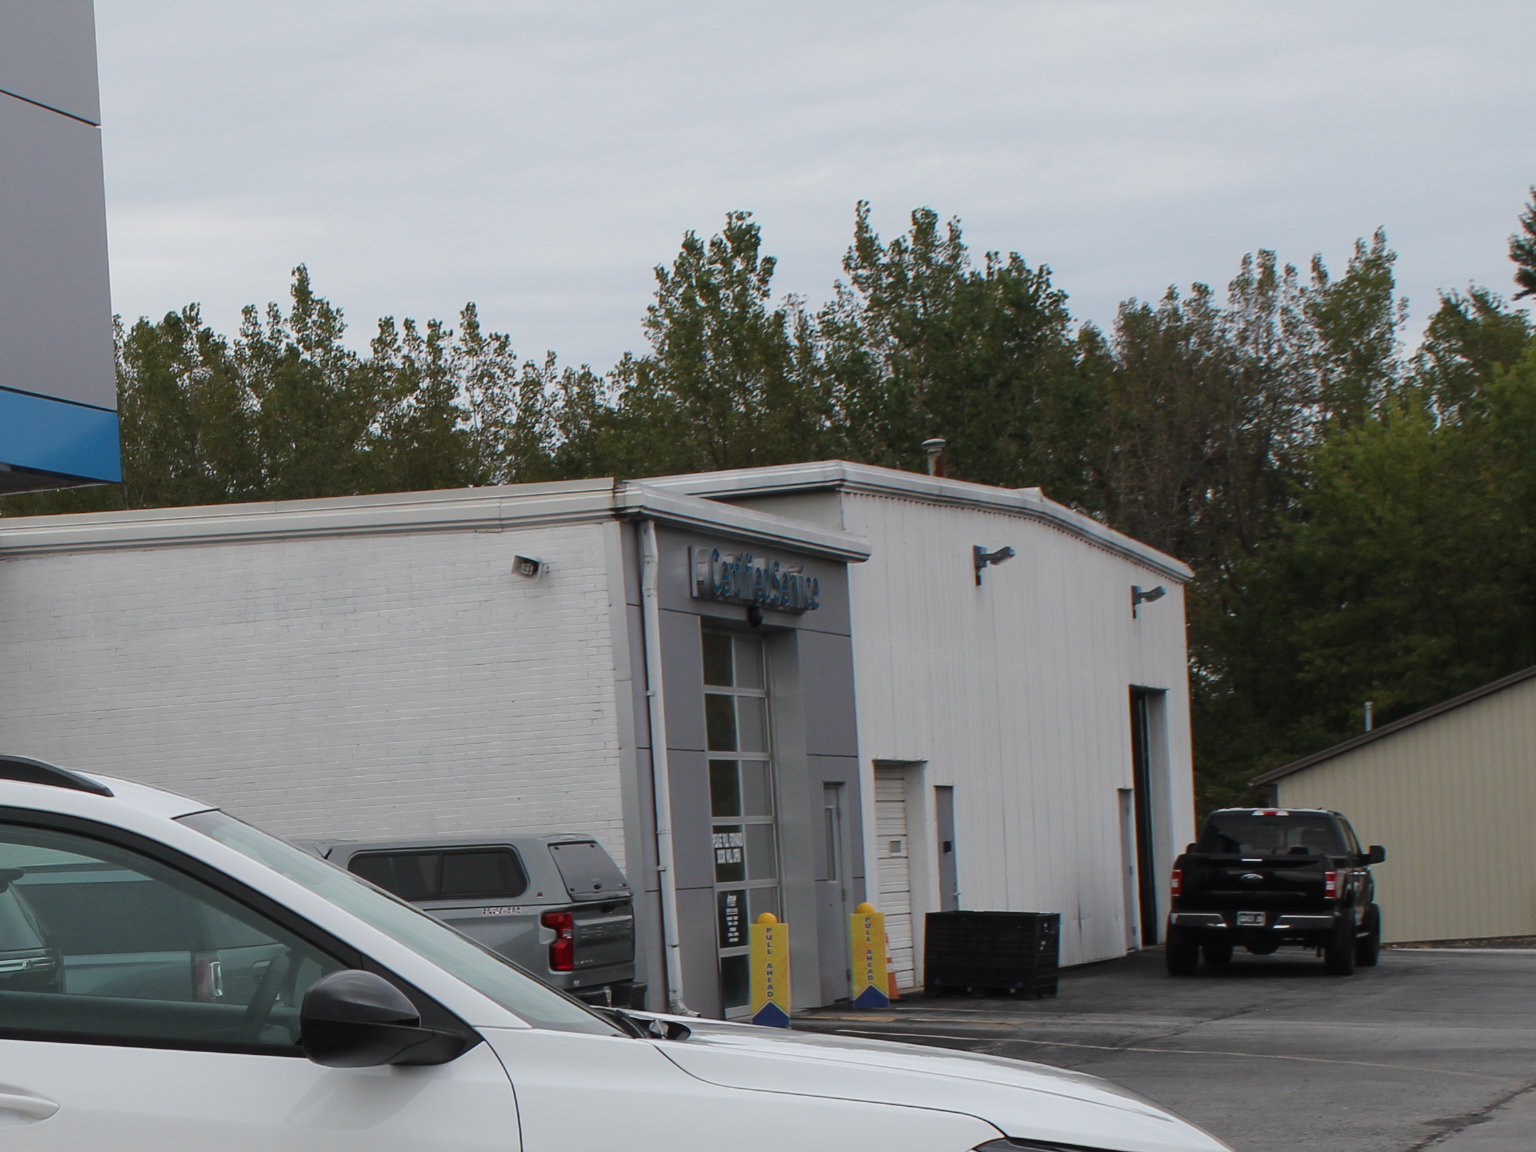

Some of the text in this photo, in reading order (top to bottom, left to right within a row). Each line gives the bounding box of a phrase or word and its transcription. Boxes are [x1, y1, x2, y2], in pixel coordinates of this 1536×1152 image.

[712, 548, 820, 610] Certified Service
[765, 927, 774, 998] PULL AHEAD
[866, 949, 874, 981] AHEAD
